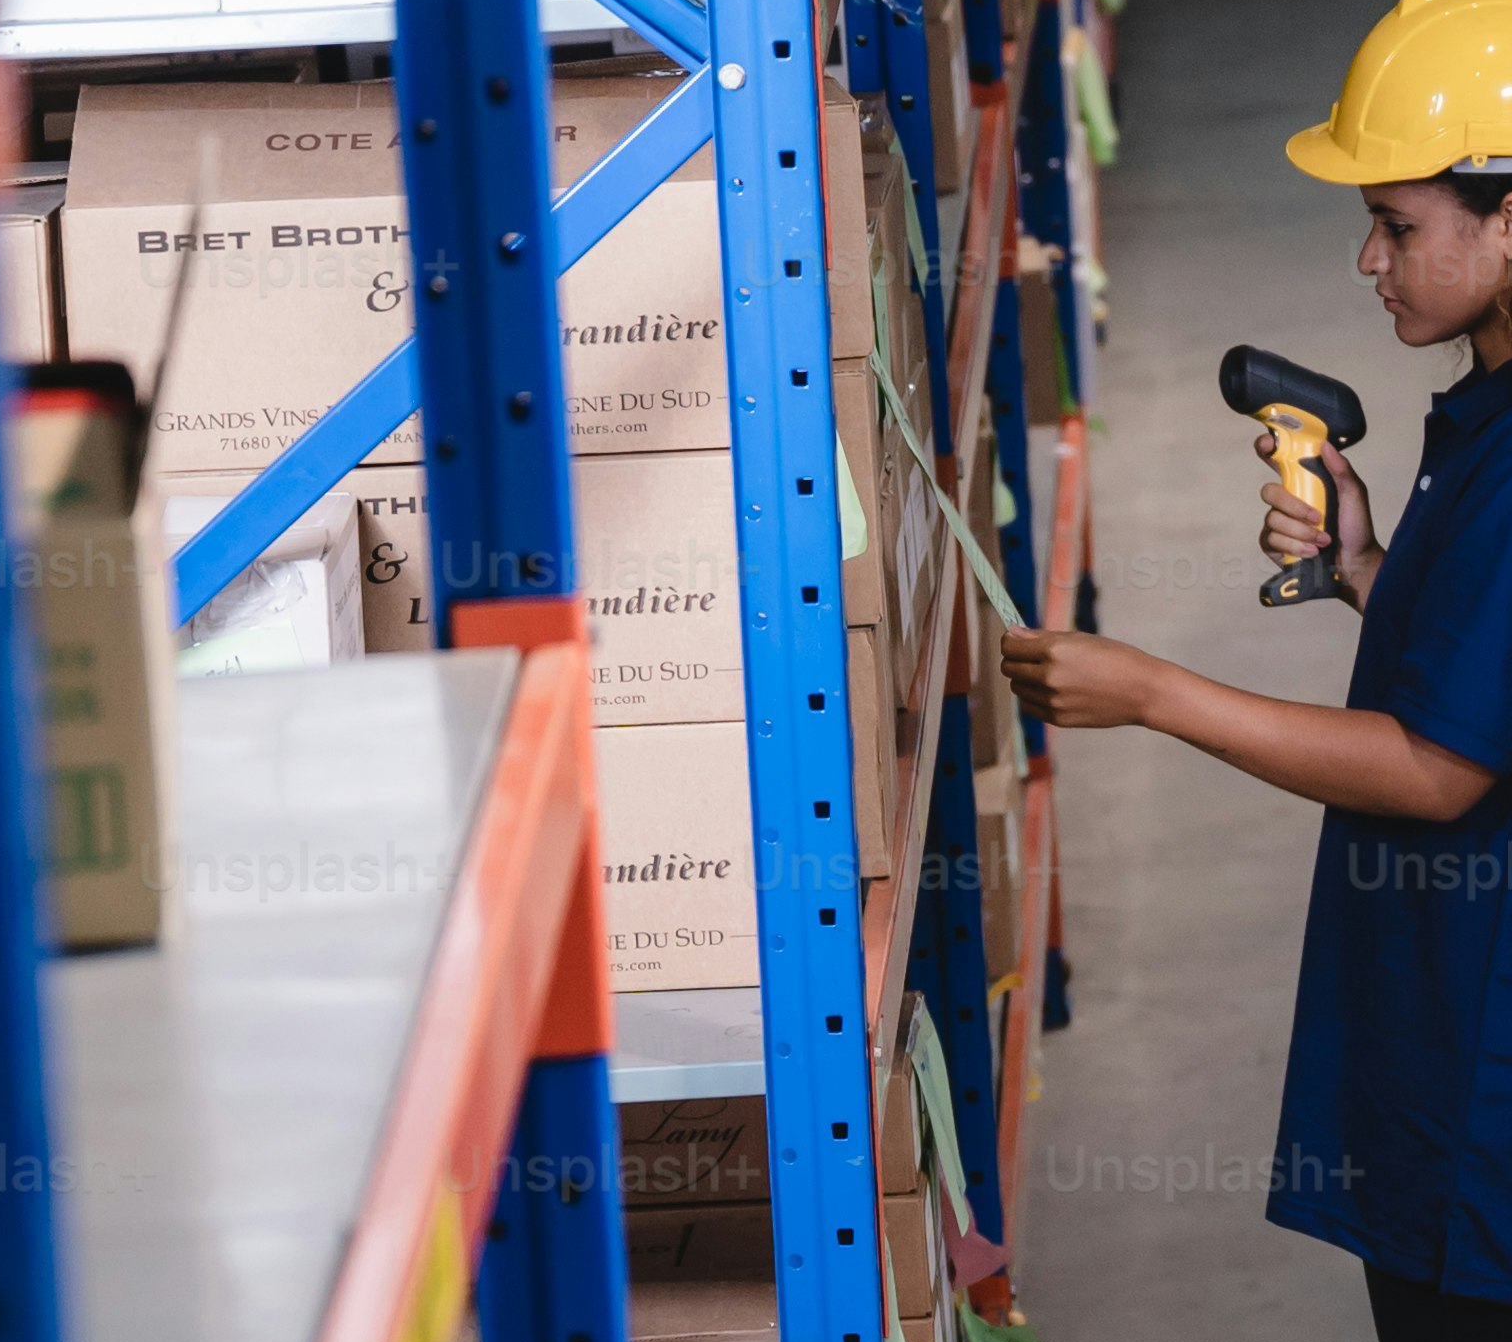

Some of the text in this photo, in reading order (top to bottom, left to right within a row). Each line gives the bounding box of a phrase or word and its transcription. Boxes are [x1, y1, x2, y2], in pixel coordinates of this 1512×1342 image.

[265, 133, 373, 151] COTE
[137, 230, 250, 254] BRET
[366, 271, 409, 312] &
[662, 389, 711, 409] SUD
[154, 410, 256, 432] GRANDS
[220, 436, 271, 451] 71680
[365, 542, 409, 584] &
[659, 661, 709, 681] SUD
[675, 927, 725, 948] SUD
